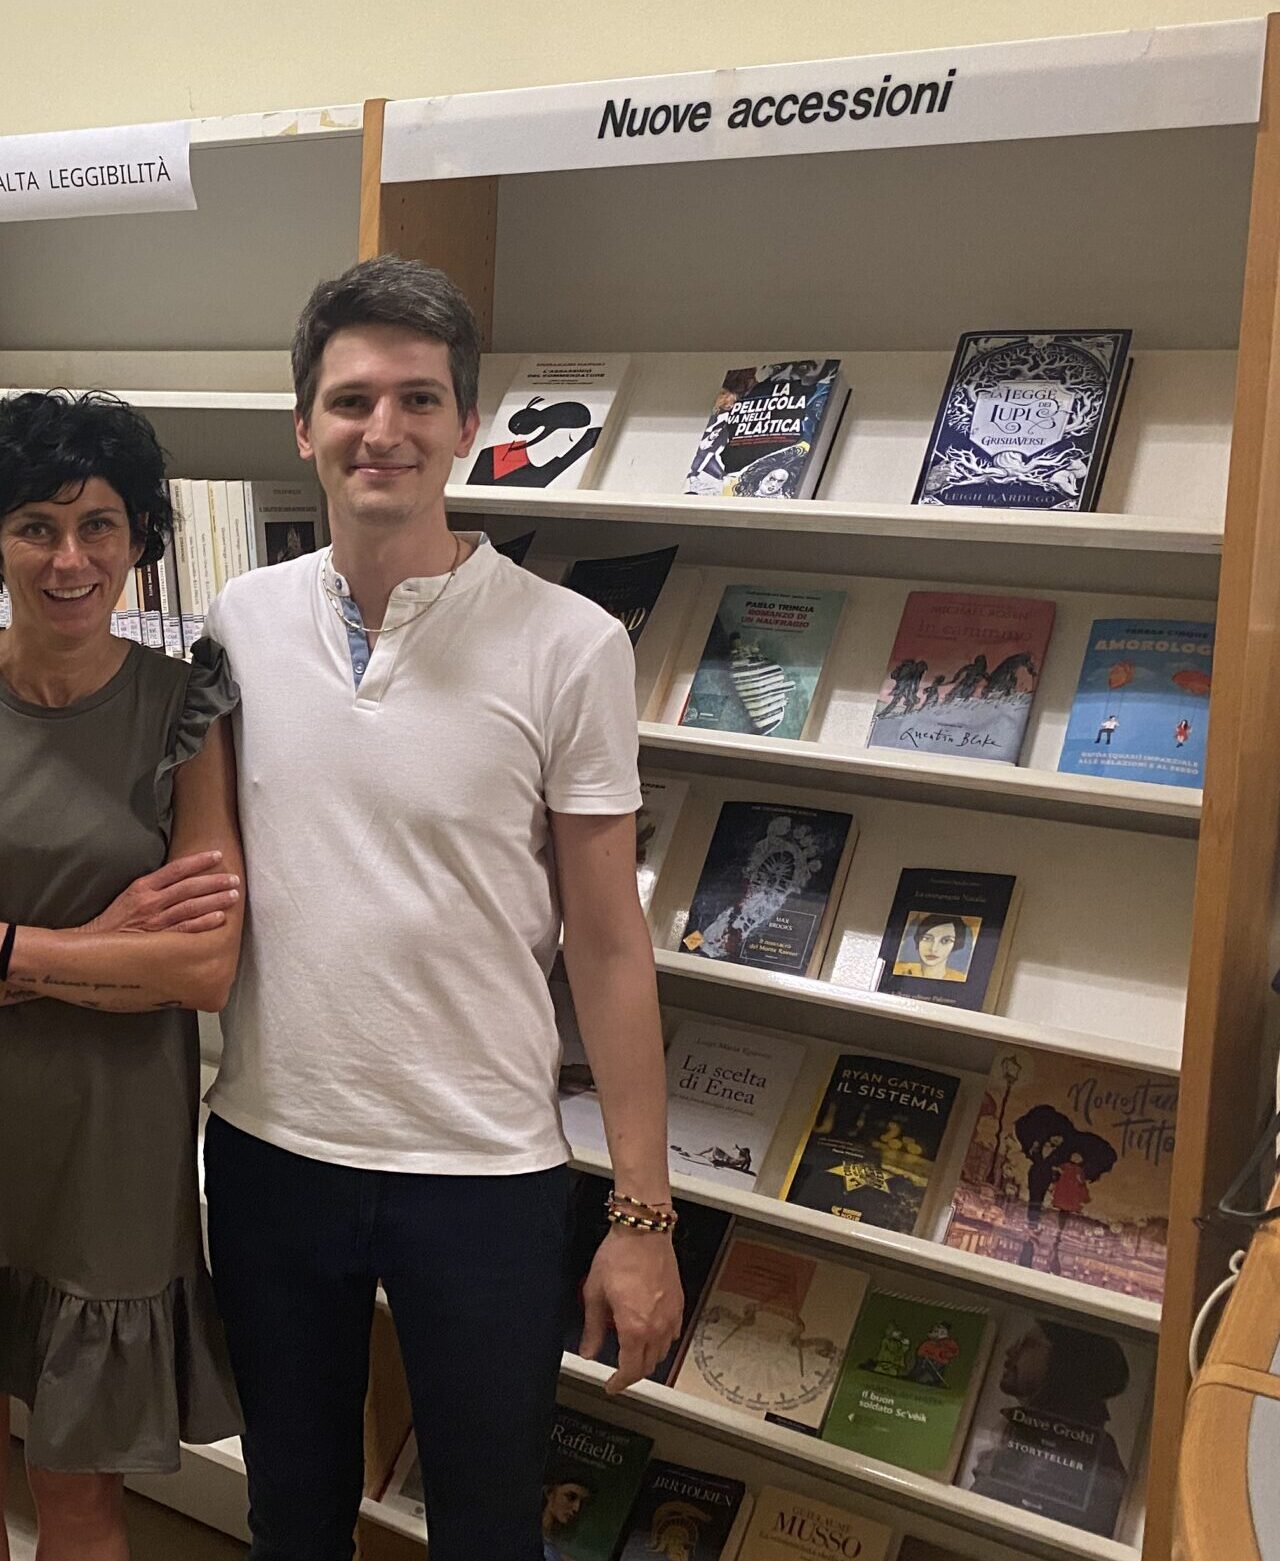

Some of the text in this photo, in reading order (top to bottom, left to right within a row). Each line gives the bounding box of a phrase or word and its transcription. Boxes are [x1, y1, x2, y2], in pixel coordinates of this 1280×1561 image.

[598, 69, 957, 139] Nuove accessioni
[48, 156, 171, 189] LEGGIBILITÀ
[772, 383, 791, 397] LA
[991, 388, 1058, 403] LA LEGGE
[730, 396, 806, 415] PELLICOLA
[990, 404, 1031, 422] LUPI
[727, 411, 771, 424] VA NELLA
[735, 418, 801, 436] PLASTICA
[745, 601, 814, 613] PABLO TRINCIA
[747, 609, 794, 619] ROMANZO
[756, 618, 810, 629] NAUFRAGIO
[1094, 639, 1212, 656] AMOROLOG
[899, 728, 1003, 747] Quentin Blake
[682, 1054, 767, 1089] La scelta
[679, 1073, 755, 1105] di Enea
[841, 1069, 945, 1099] RYAN GATTIS
[836, 1082, 940, 1115] IL SISTEMA
[869, 1390, 895, 1404] buon
[859, 1400, 893, 1414] soldato
[1012, 1409, 1095, 1445] Dave Grohl
[550, 1424, 623, 1465] Raffaello
[1007, 1439, 1084, 1471] STORYTELLER
[773, 1512, 862, 1559] MUSSO
